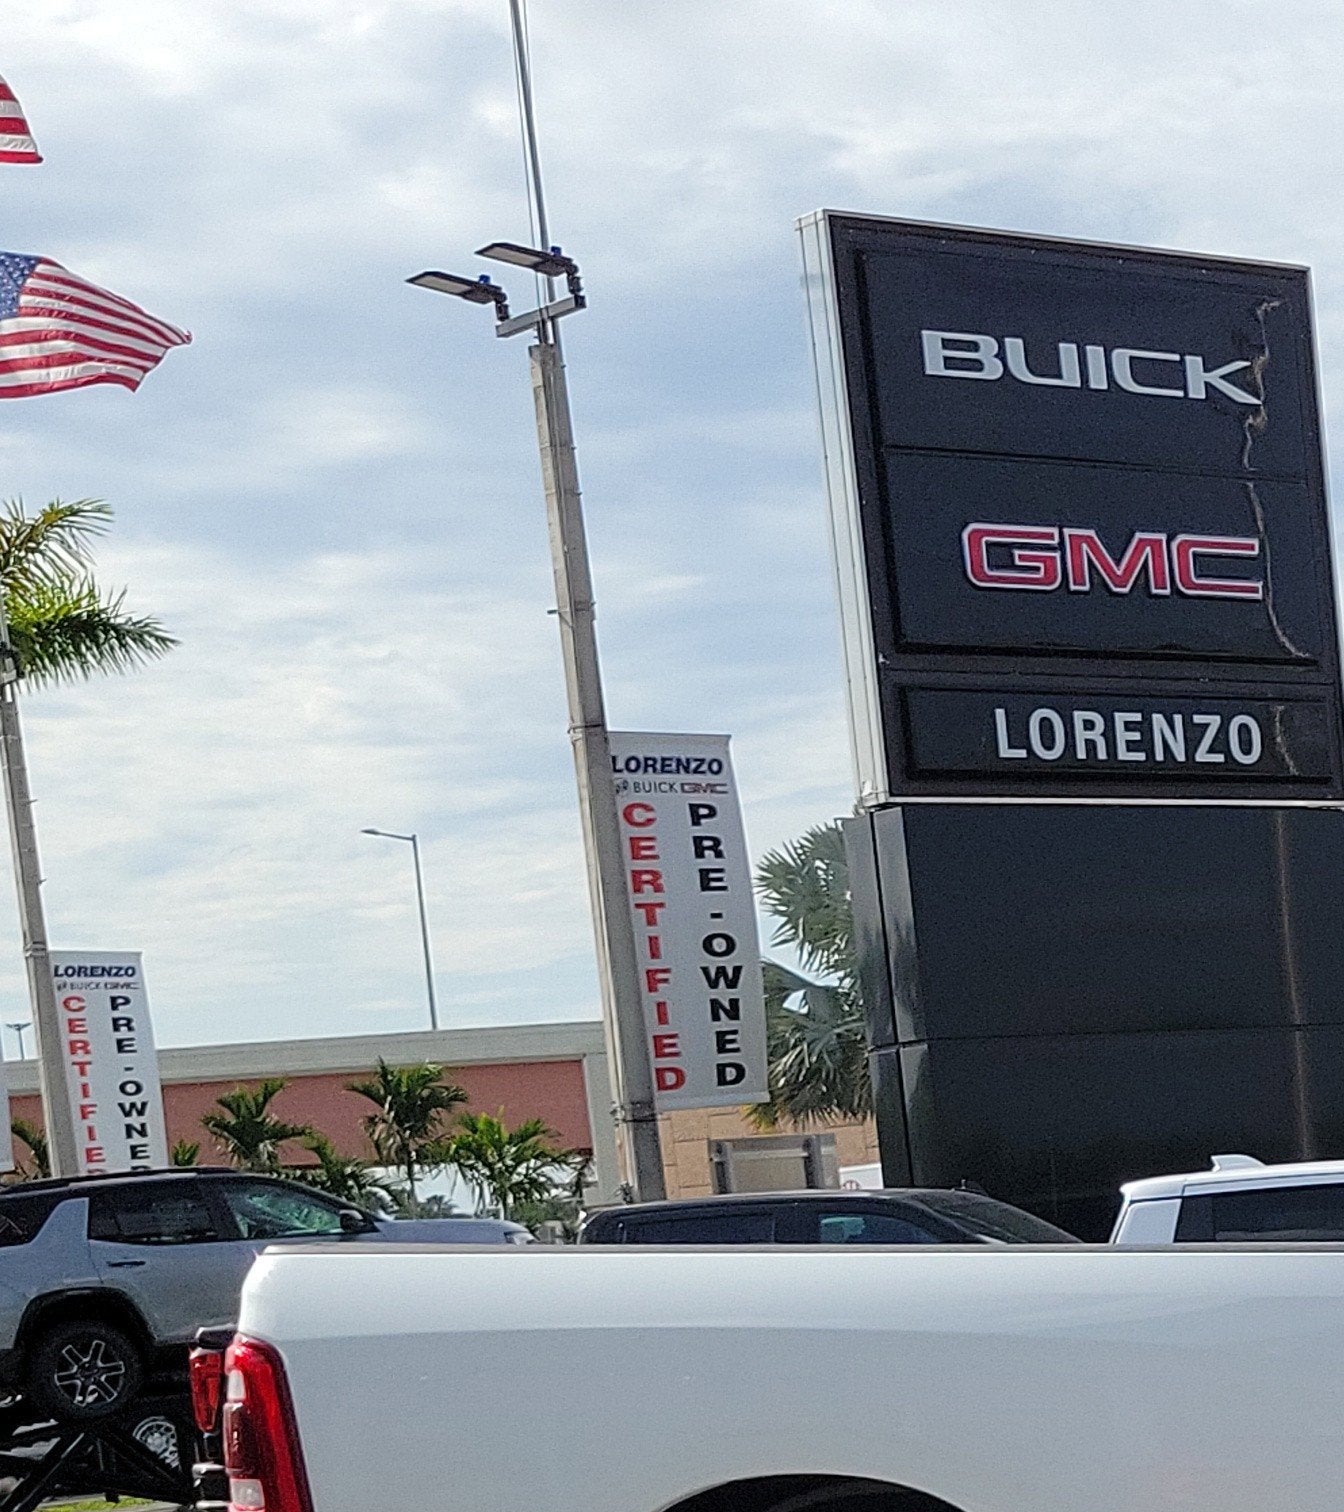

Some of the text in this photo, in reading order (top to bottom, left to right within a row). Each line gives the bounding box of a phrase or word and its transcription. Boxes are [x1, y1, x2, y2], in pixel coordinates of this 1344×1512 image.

[920, 329, 1263, 405] BUICK
[962, 522, 1264, 601] GMC
[611, 755, 723, 775] LORENZO
[994, 708, 1263, 765] LORENZO
[633, 781, 728, 794] BUICK GMC
[54, 964, 137, 977] LORENZO
[622, 802, 686, 1092] CERTIFIED
[688, 802, 746, 1087] PRE-OWNED
